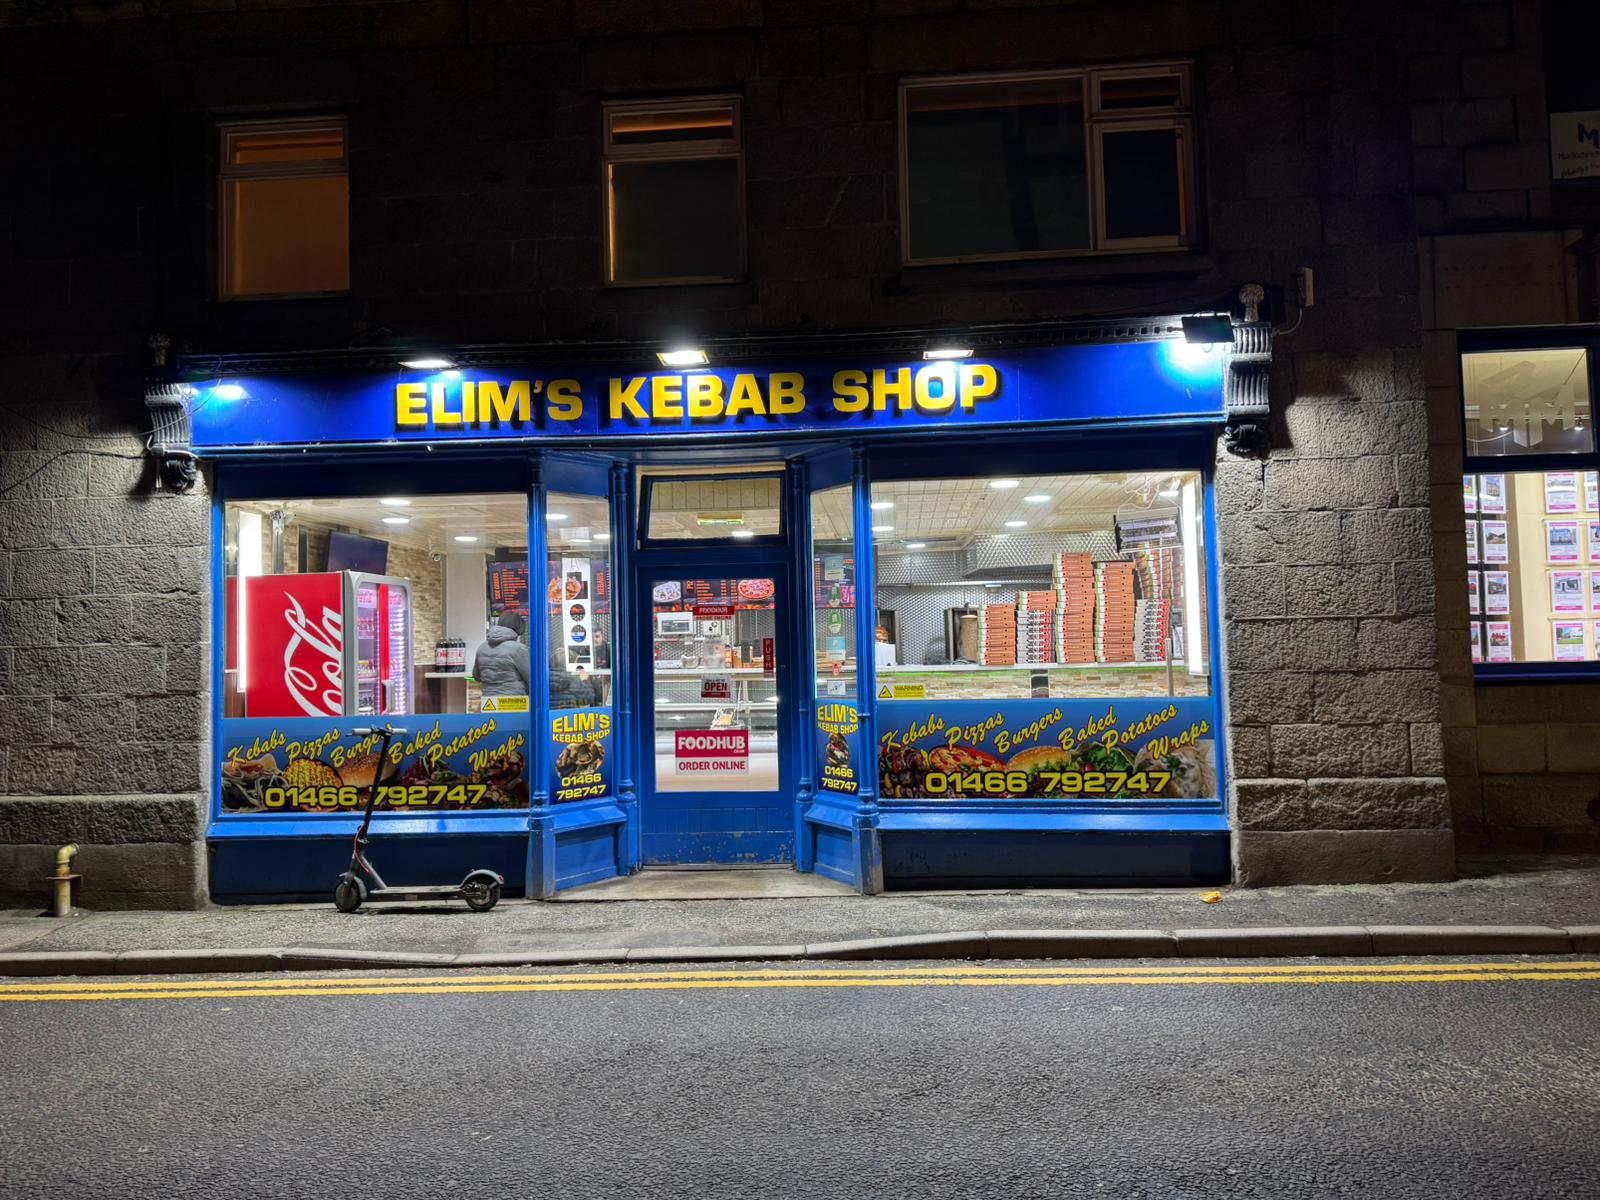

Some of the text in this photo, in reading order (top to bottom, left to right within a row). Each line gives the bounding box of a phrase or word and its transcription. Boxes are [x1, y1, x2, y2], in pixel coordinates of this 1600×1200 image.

[397, 365, 996, 424] ELIM'S KEBAB SHOP
[704, 682, 727, 691] OPEN
[818, 705, 858, 723] ELIM'S
[552, 713, 611, 733] ELIM'S
[817, 724, 858, 734] KEBAB SHOP
[552, 729, 609, 743] KEBAB SHOP
[881, 703, 1210, 760] Kebabs Pizzas Burgers Baked Potatoes Wraps
[227, 718, 525, 772] Kebabs Pizzas Burge Baked Potatoes Wraps
[677, 736, 746, 750] FOODHUB
[679, 760, 745, 771] ORDER ONLINE
[825, 767, 853, 778] 01466
[561, 773, 602, 786] 01466
[822, 778, 857, 791] 792747
[926, 771, 1171, 793] 01466 792747
[265, 784, 487, 807] 01466 792747
[557, 785, 606, 799] 792747
